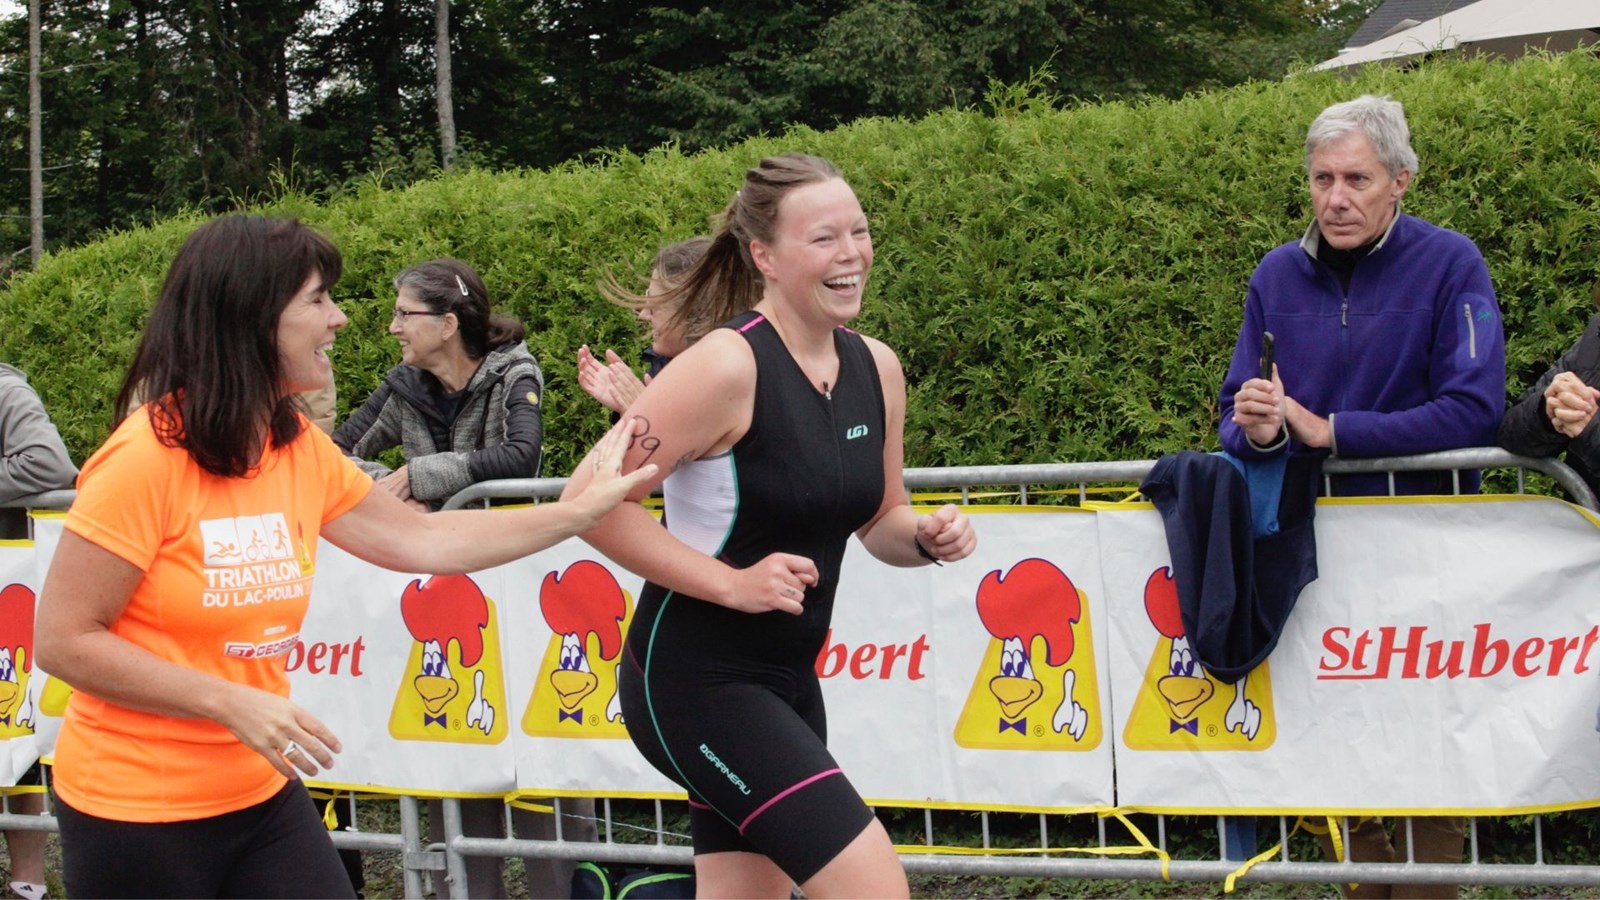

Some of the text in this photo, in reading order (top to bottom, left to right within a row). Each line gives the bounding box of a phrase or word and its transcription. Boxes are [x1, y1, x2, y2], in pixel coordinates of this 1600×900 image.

[203, 560, 302, 588] TRIATHLON
[202, 592, 229, 608] DU
[233, 582, 304, 607] LAC-POULIN
[814, 628, 930, 680] bert
